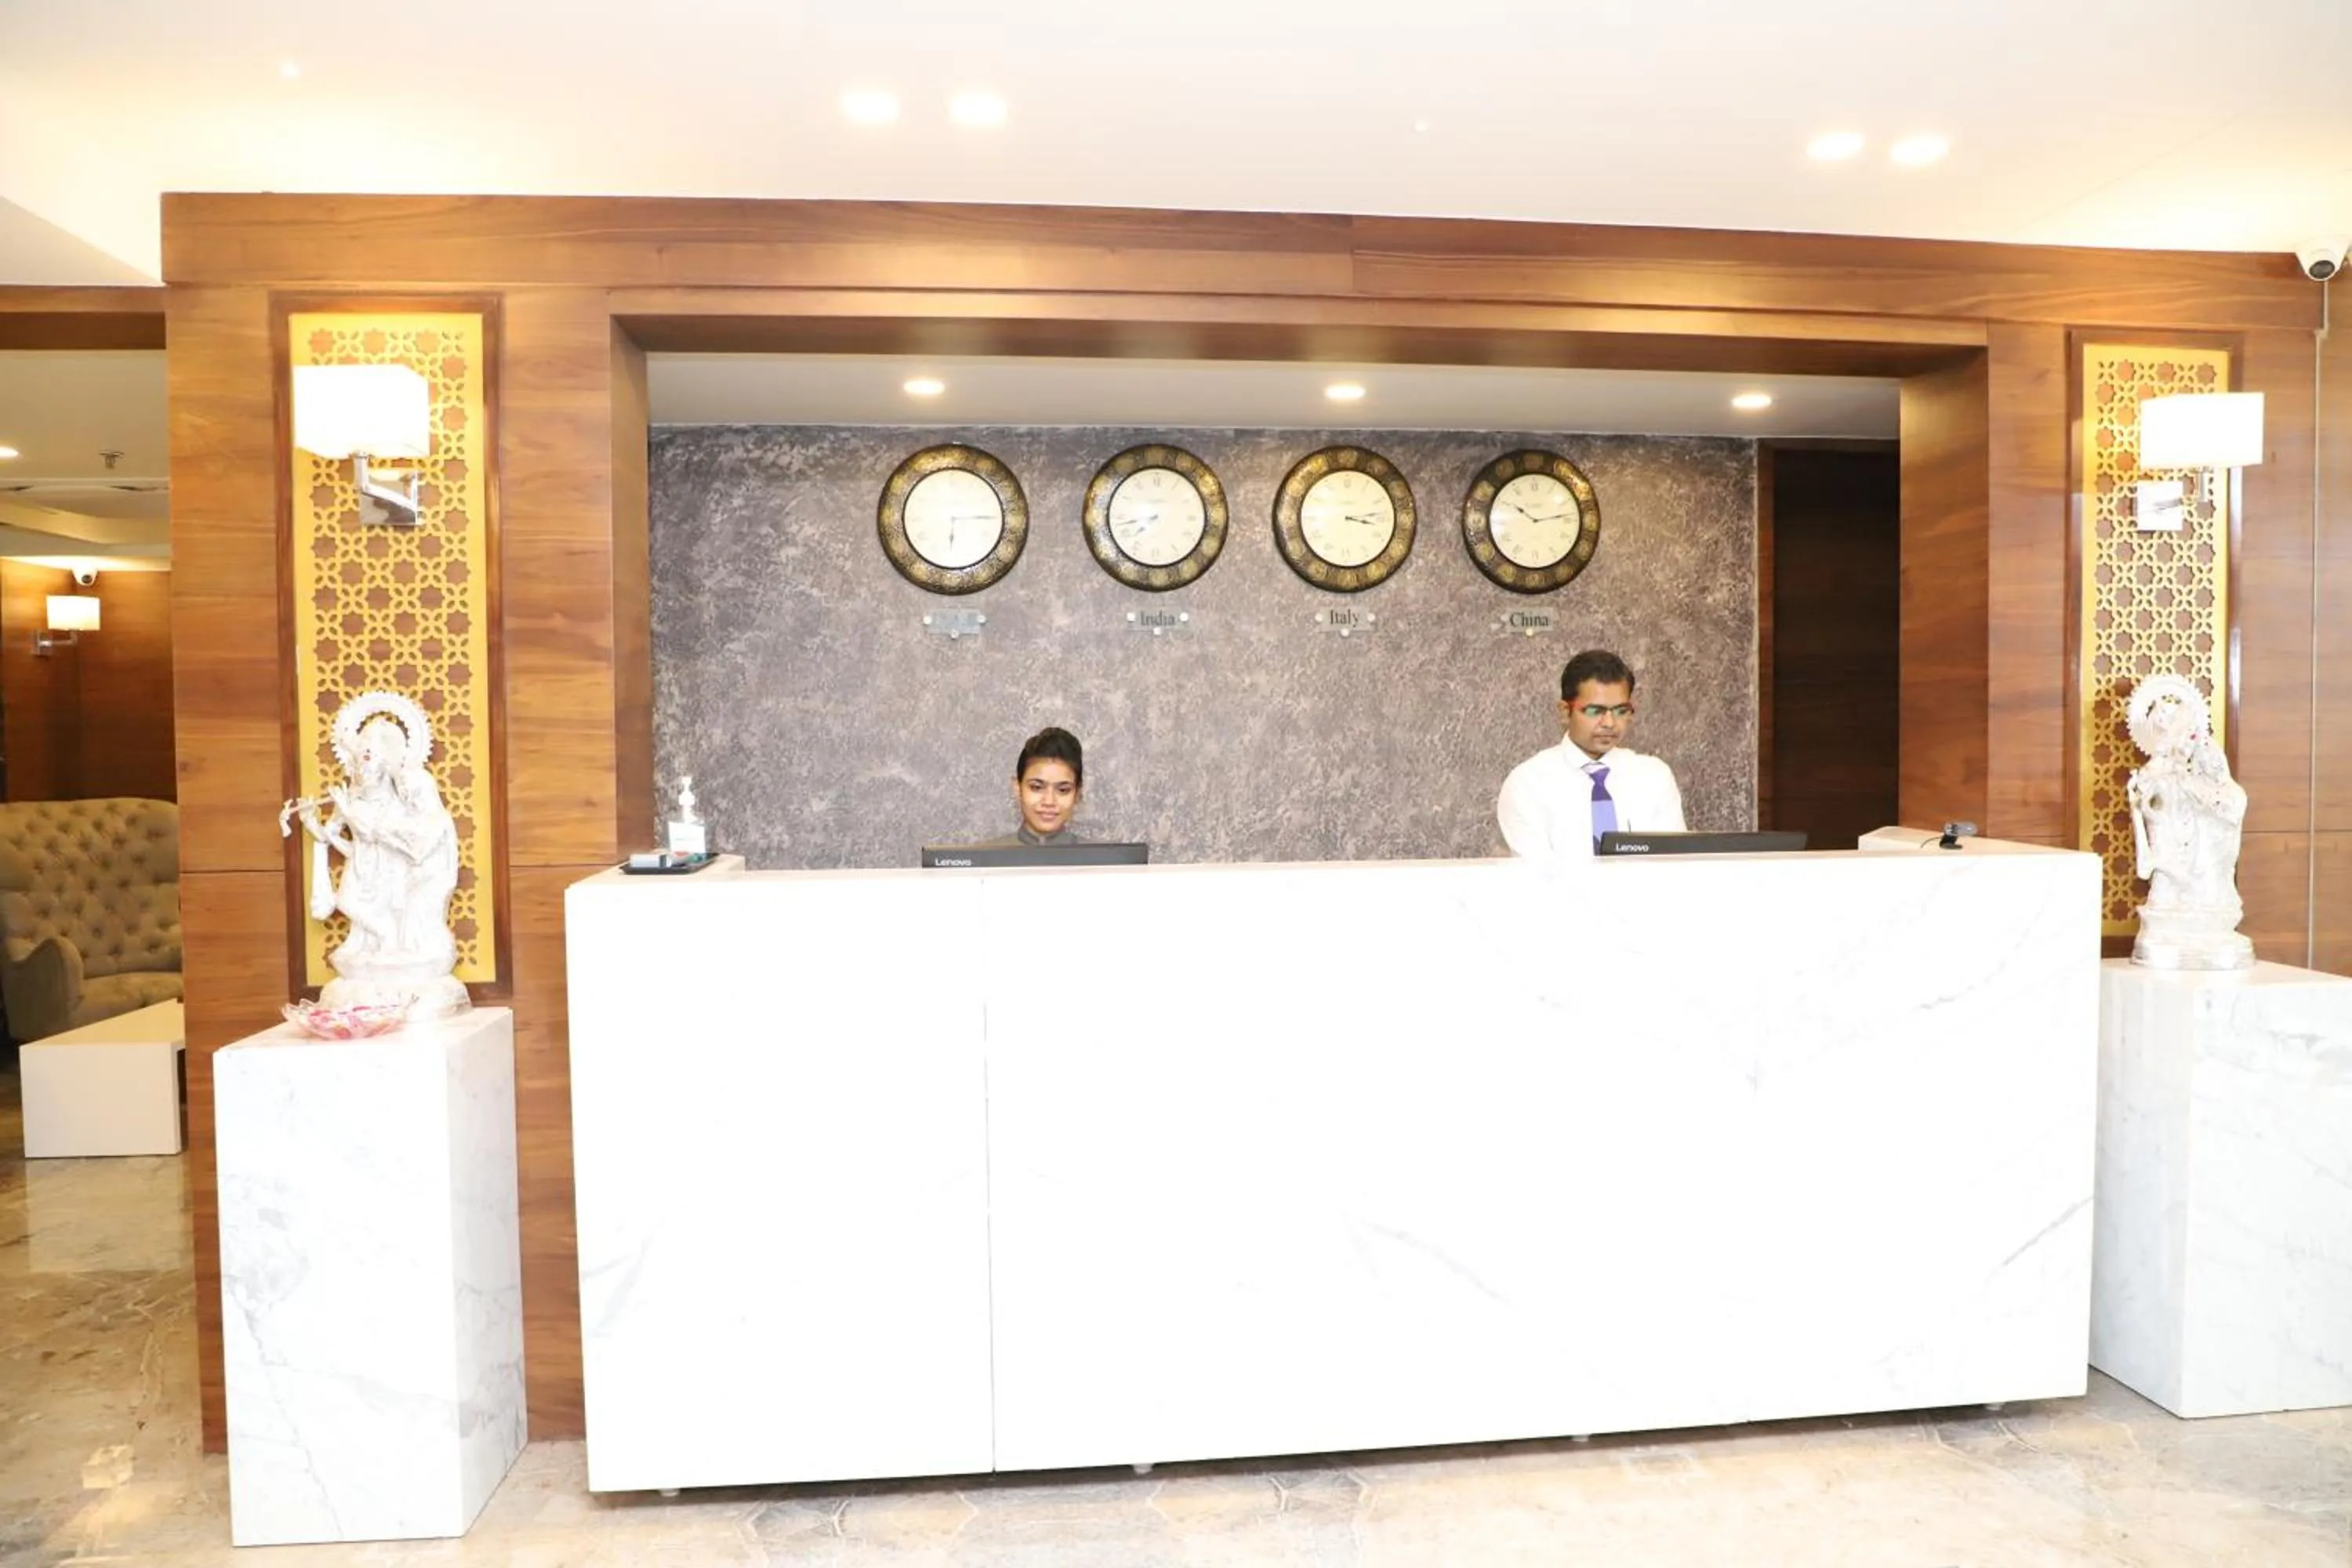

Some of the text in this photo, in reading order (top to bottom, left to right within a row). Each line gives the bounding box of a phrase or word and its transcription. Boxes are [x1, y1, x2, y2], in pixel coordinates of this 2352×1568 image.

[1141, 610, 1175, 626] India
[1330, 608, 1360, 628] Italy
[1509, 611, 1549, 627] China
[1616, 842, 1650, 852] Lenovo
[935, 858, 971, 866] Lenovo
